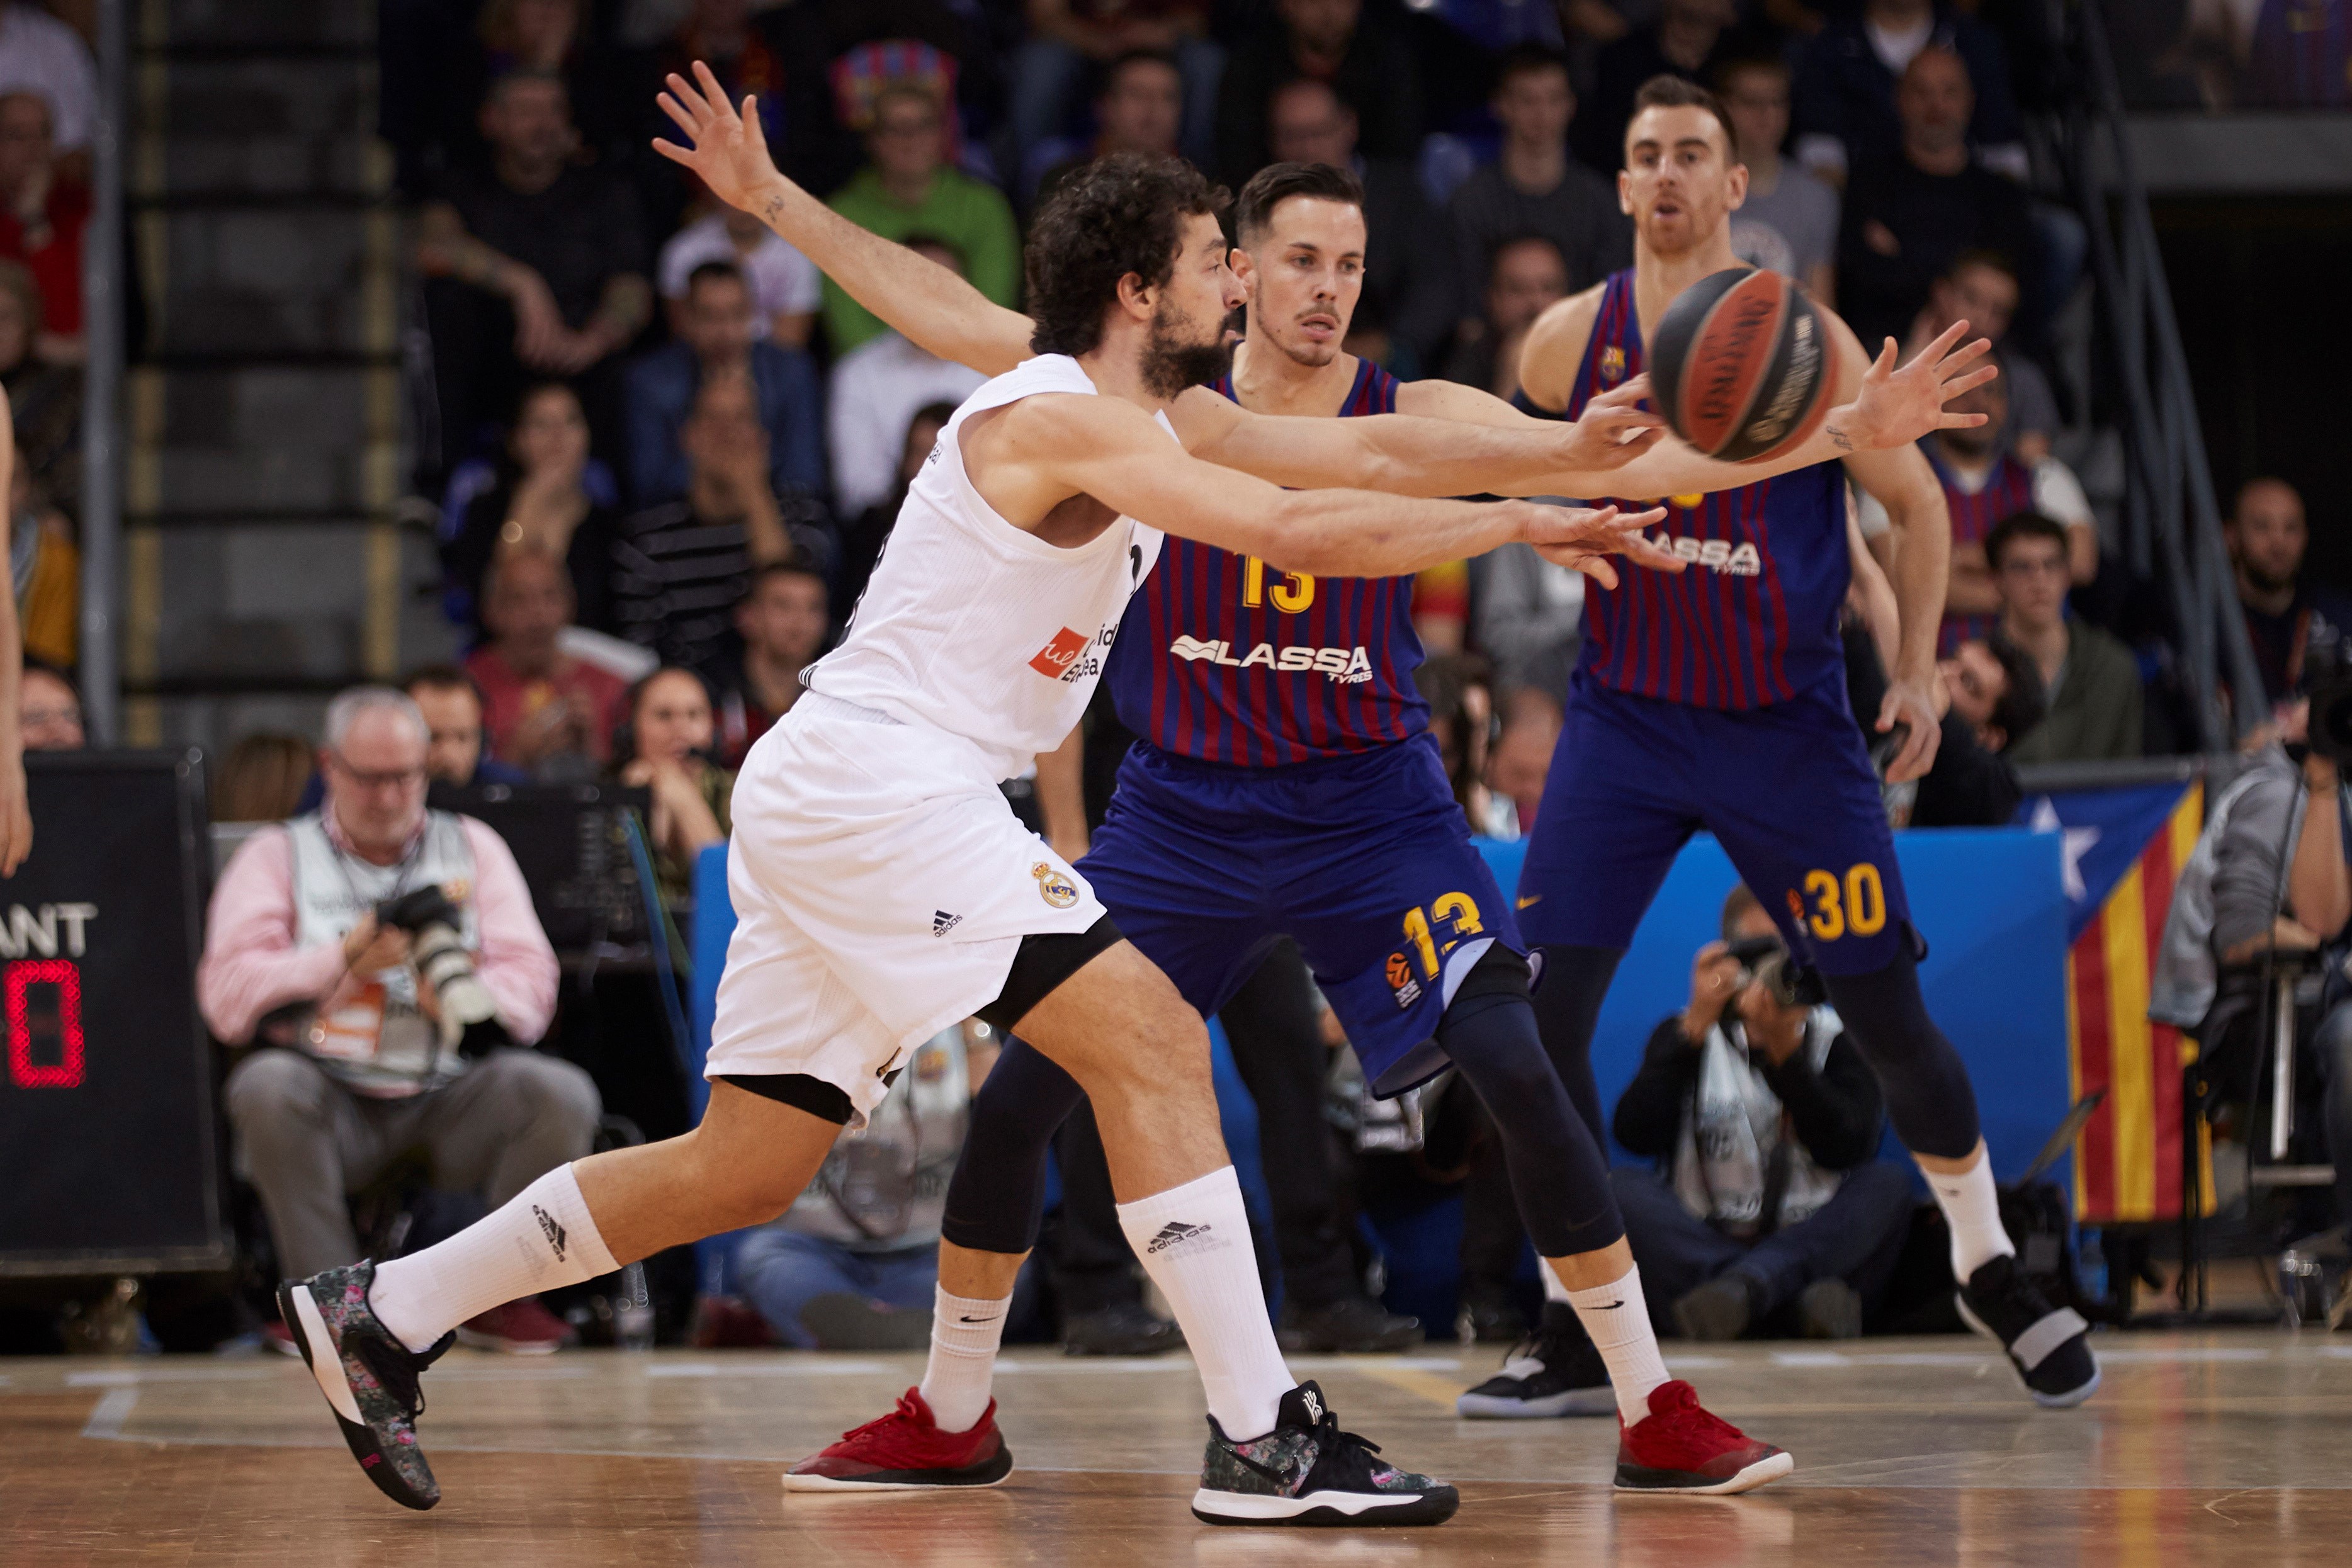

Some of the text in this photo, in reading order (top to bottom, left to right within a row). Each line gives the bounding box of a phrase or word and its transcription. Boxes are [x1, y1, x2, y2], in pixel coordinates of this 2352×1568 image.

[1636, 529, 1761, 565] ASSA
[1241, 553, 1315, 614] 13
[1214, 641, 1371, 675] LASSA
[1328, 670, 1372, 684] TYRES
[1804, 862, 1886, 942] 30
[935, 915, 963, 937] adidas
[1403, 892, 1484, 981] 13
[4, 959, 86, 1088] 0
[533, 1205, 565, 1262] adidas
[1148, 1224, 1211, 1253] adidas
